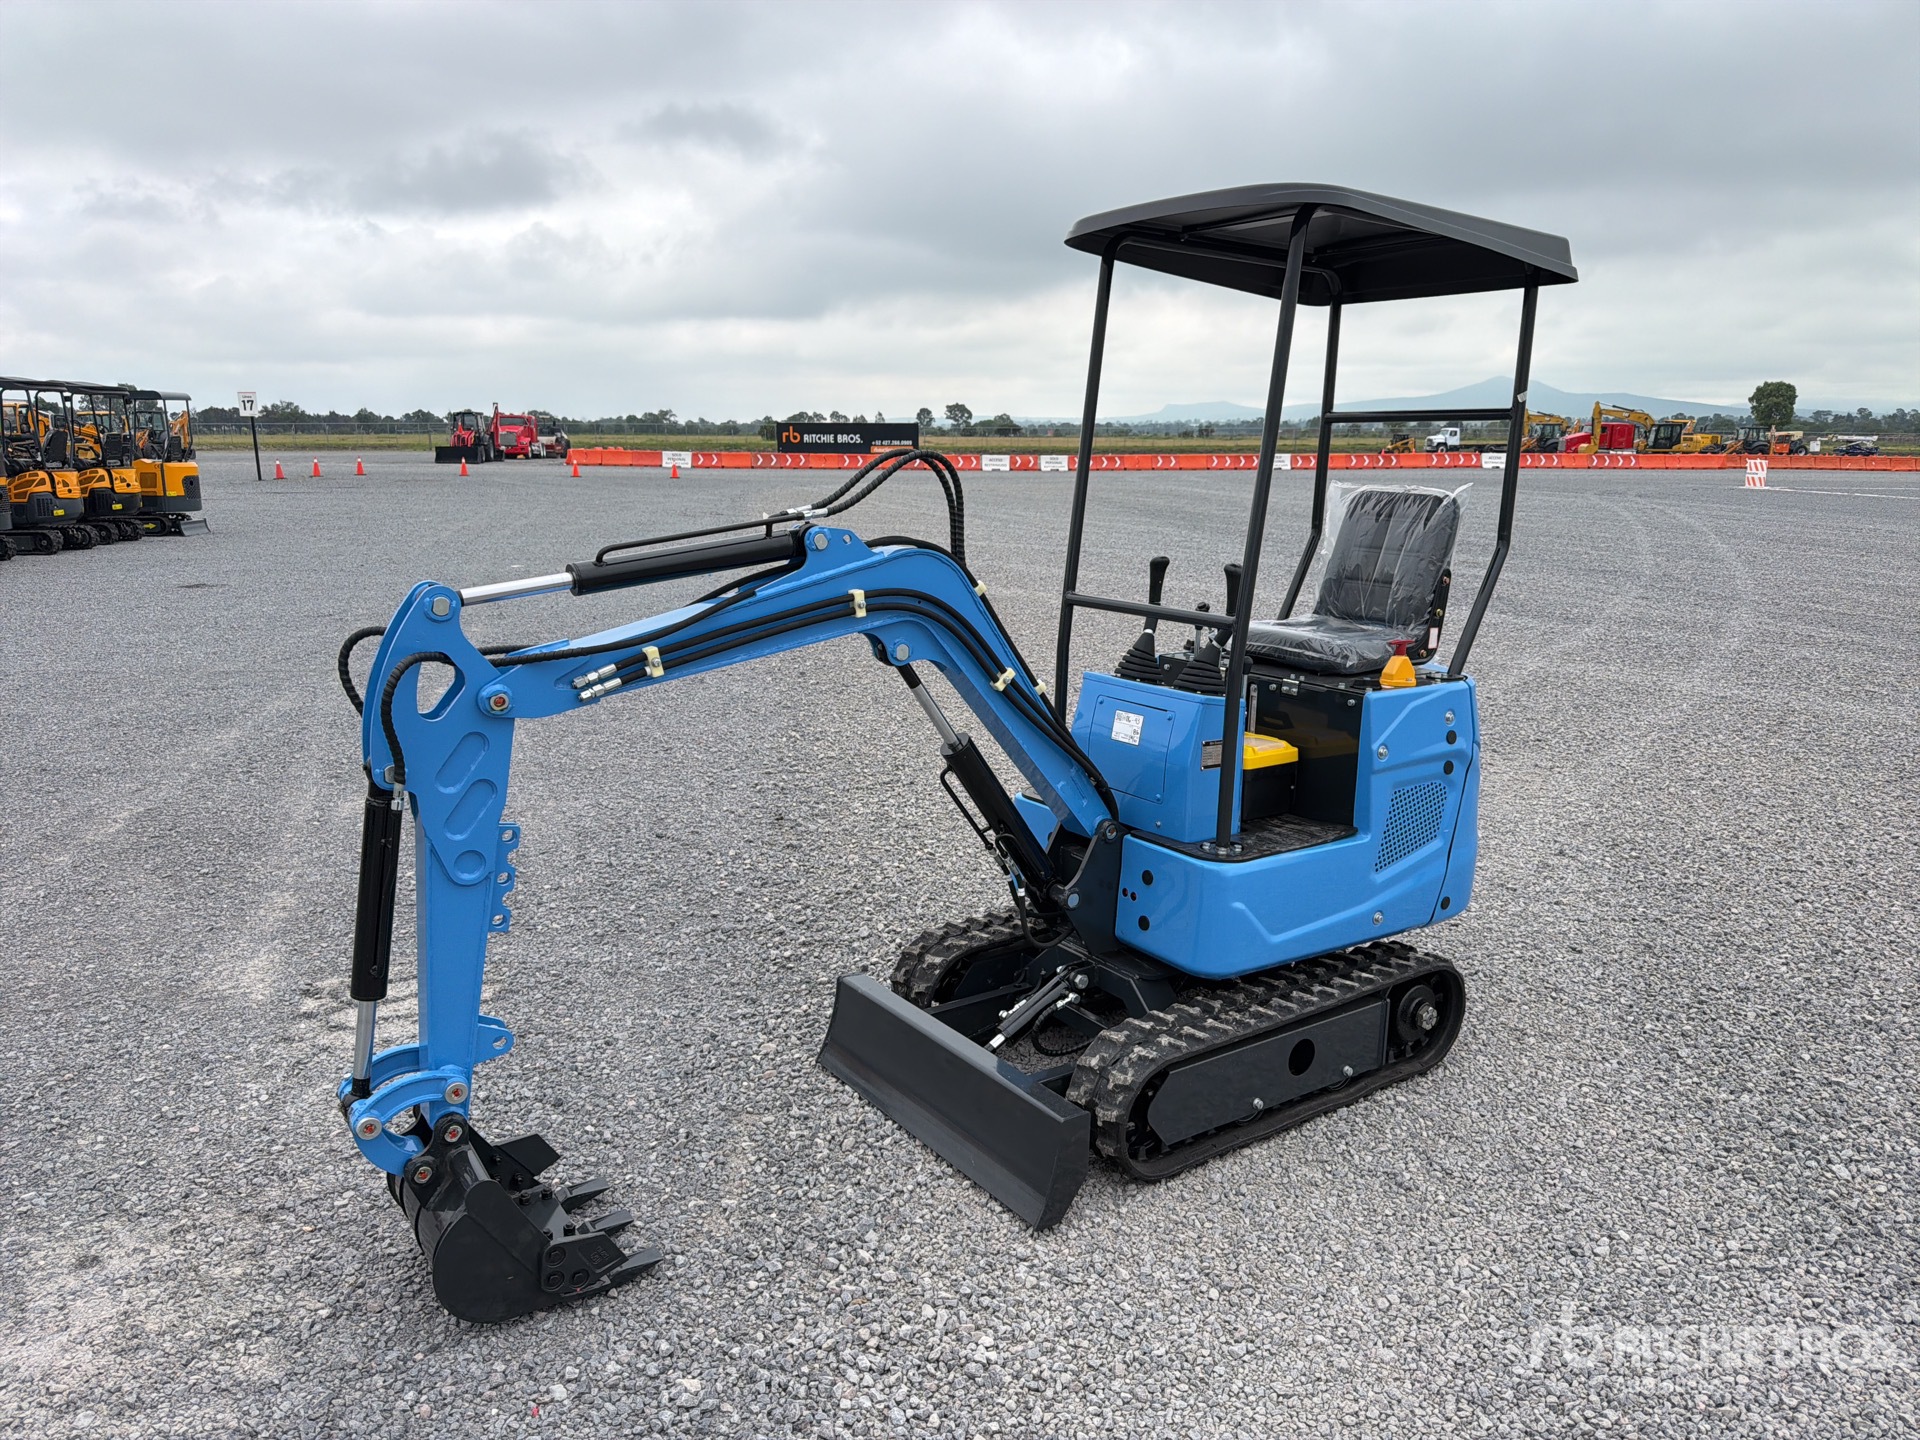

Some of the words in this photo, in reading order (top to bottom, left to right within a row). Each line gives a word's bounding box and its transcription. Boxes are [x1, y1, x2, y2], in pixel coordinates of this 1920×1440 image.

[241, 399, 254, 411] 17
[782, 425, 801, 444] rb
[803, 433, 835, 444] RITCHIE
[837, 433, 864, 444] BROS.
